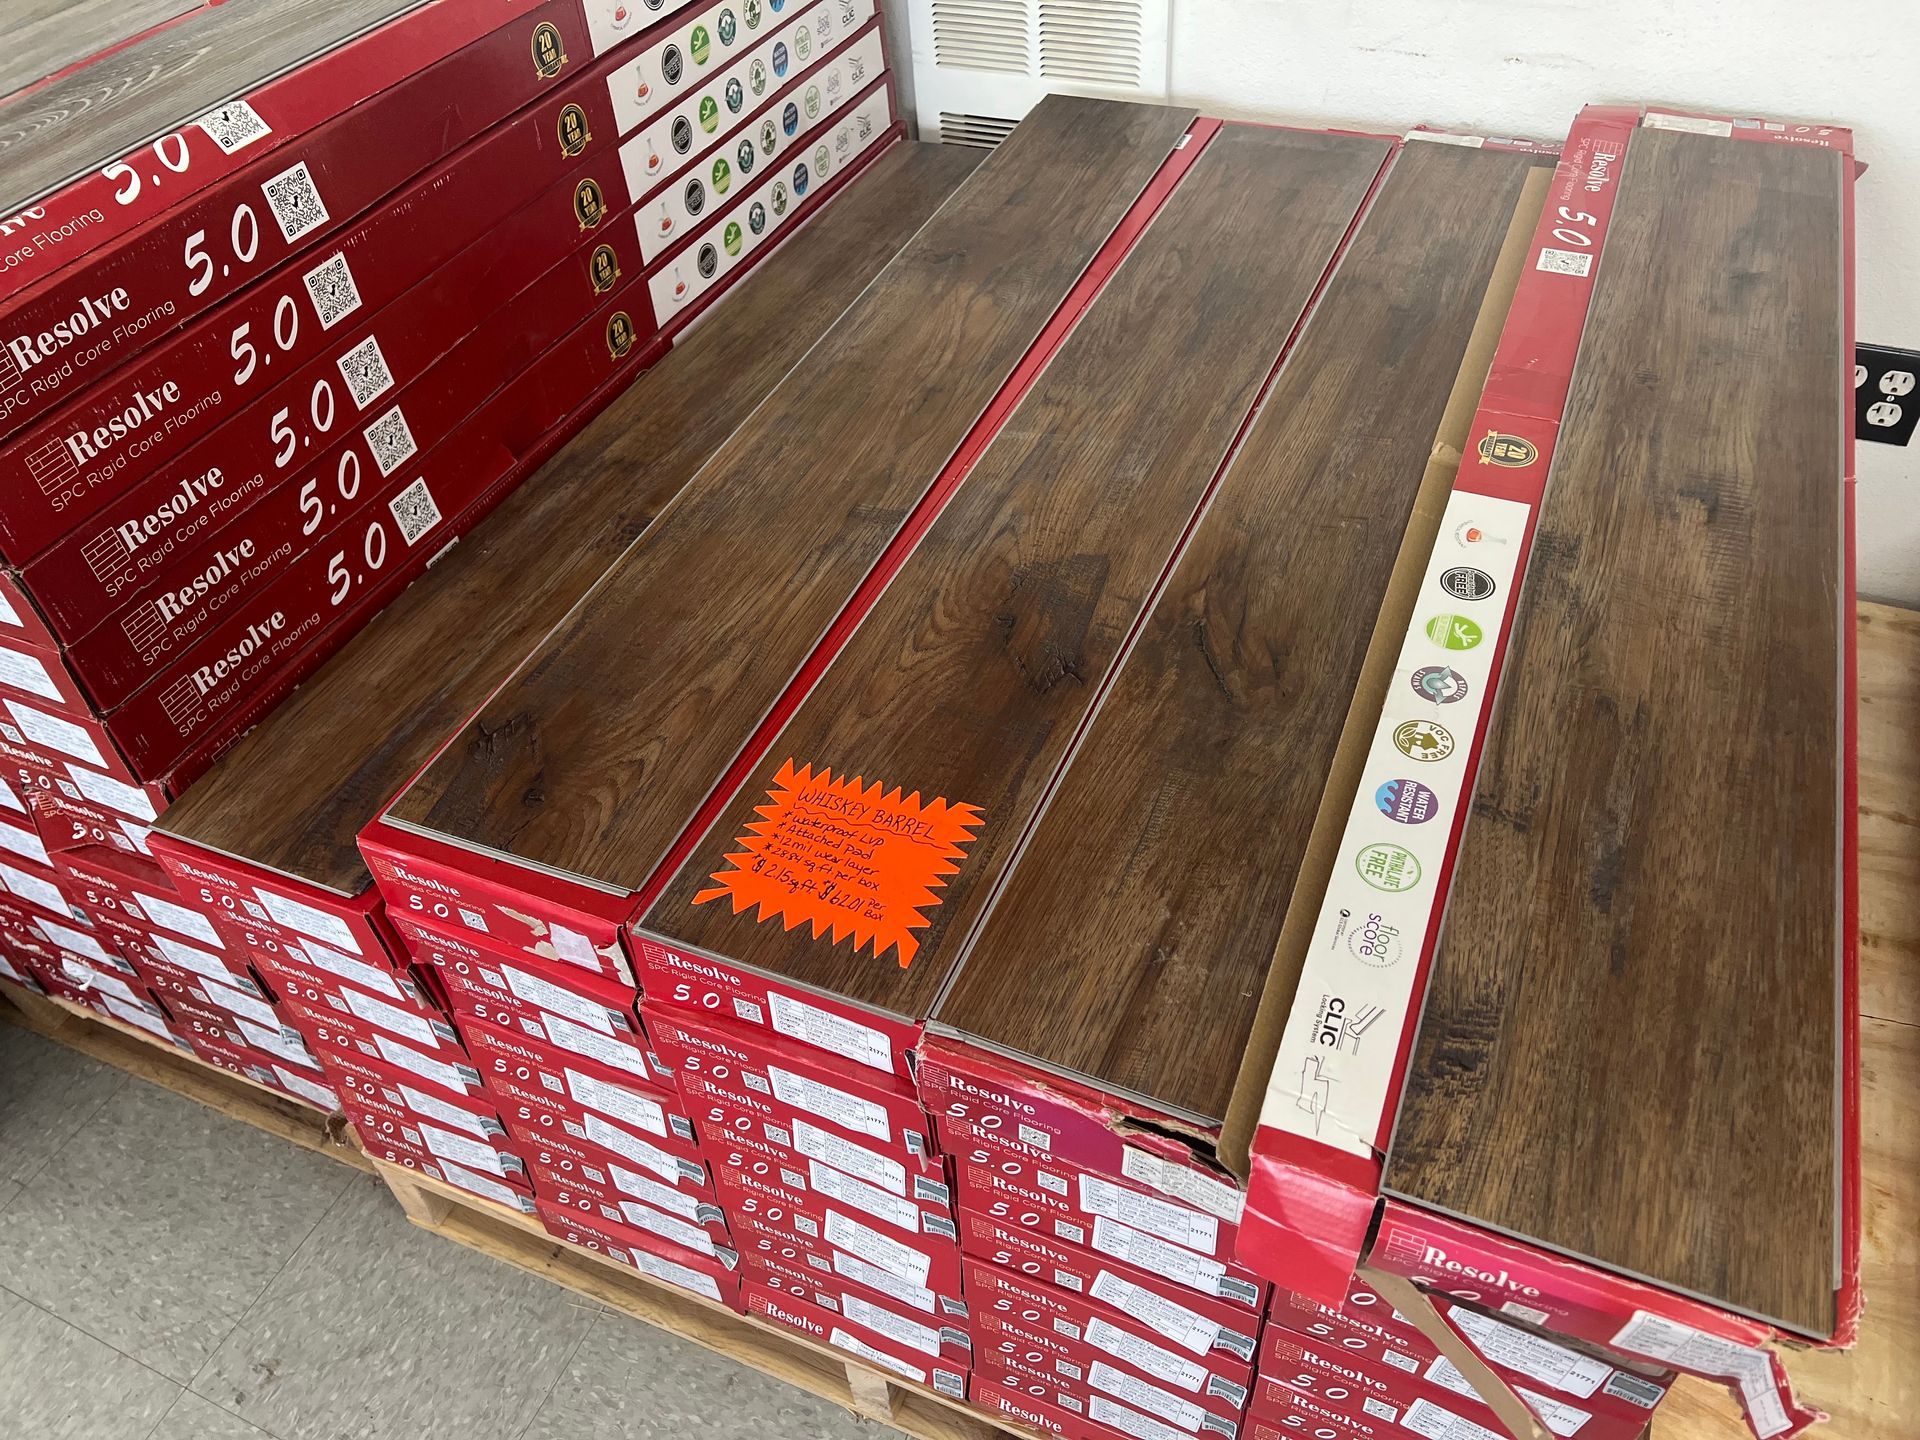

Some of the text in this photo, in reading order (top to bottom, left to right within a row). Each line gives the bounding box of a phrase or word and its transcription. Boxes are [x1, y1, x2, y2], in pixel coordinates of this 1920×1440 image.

[842, 9, 856, 24] CLIC
[538, 31, 552, 53] 20
[852, 66, 865, 81] CLIC
[564, 112, 578, 134] 20
[1580, 137, 1591, 152] SPC
[1774, 134, 1829, 147] Resolve
[101, 132, 190, 205] 5.0
[1573, 152, 1585, 165] Rigid
[1584, 151, 1616, 192] Resolve
[580, 186, 593, 206] 20
[1560, 174, 1575, 201] Flooring
[32, 207, 104, 250] Flooring
[1552, 206, 1597, 246] 5.0
[185, 203, 259, 296] 5.0
[596, 252, 608, 271] 20
[7, 286, 130, 373] Resolve
[230, 294, 299, 386] 5.0
[613, 319, 624, 337] 20
[30, 362, 73, 396] Rigid
[74, 339, 111, 368] Core
[112, 300, 176, 344] Flooring
[64, 380, 181, 466] Resolve
[271, 379, 334, 468] 5.0
[51, 390, 222, 512] SPC Rigid Core Flooring
[1507, 444, 1528, 460] 20
[300, 450, 360, 536] 5.0
[117, 467, 224, 553] Resolve
[105, 473, 264, 598] SPC Rigid Core Flooring
[327, 522, 386, 606] 5.0
[155, 538, 255, 623] Resolve
[1454, 571, 1468, 595] FREE
[142, 542, 292, 666] SPC Rigid Core Flooring
[191, 610, 286, 696] Resolve
[179, 612, 321, 737] SPC Rigid Core Flooring
[1412, 669, 1426, 690] STAINS
[1453, 679, 1468, 699] REPELS
[1421, 724, 1450, 760] VOC FREE
[798, 787, 935, 840] WHISKEY BARREL
[1396, 780, 1418, 823] RESISTANT
[1412, 791, 1431, 821] WATER
[72, 821, 105, 841] 5.0
[786, 824, 874, 860] Attached pad
[180, 862, 239, 889] Resolve
[814, 850, 843, 863] wear
[844, 858, 880, 876] layer
[1365, 850, 1388, 879] FREE
[394, 865, 460, 898] Resolve
[834, 871, 856, 882] per
[858, 877, 880, 891] box
[200, 889, 235, 909] 5.0
[409, 894, 449, 918] 5.0
[864, 909, 884, 921] Box
[417, 927, 479, 958] Resolve
[1360, 912, 1382, 956] score
[1373, 924, 1400, 962] floor
[433, 952, 470, 975] 5.0
[667, 953, 742, 986] Resolve
[462, 979, 523, 1008] Resolve
[648, 962, 767, 1005] SPC Rigid Core Flooring
[673, 984, 720, 1009] 5.0
[475, 1004, 511, 1026] 5.0
[1310, 994, 1329, 1043] Locking System
[1319, 997, 1345, 1047] CLIC
[676, 1030, 749, 1062] Resolve
[869, 1046, 888, 1058] 21771
[684, 1056, 729, 1079] 5.0
[686, 1088, 706, 1099] SPC
[707, 1094, 731, 1108] Rigid
[733, 1103, 755, 1116] Core
[704, 1081, 772, 1114] Resolve
[924, 1081, 1061, 1135] SPC Rigid Core Flooring
[950, 1076, 1037, 1115] Resolve
[708, 1107, 751, 1130] 5.0
[946, 1102, 1003, 1129] 5.0
[723, 1129, 788, 1159] Resolve
[971, 1124, 1053, 1163] Resolve
[727, 1152, 769, 1174] 5.0
[969, 1150, 1022, 1175] 5.0
[740, 1174, 804, 1206] Resolve
[992, 1175, 1070, 1212] Resolve
[742, 1198, 783, 1221] 5.0
[989, 1202, 1040, 1226] 5.0
[752, 1220, 814, 1248] Resolve
[995, 1228, 1068, 1263] Resolve
[1190, 1227, 1212, 1239] 21771
[757, 1239, 796, 1259] 5.0
[992, 1251, 1041, 1275] 5.0
[763, 1259, 824, 1288] Resolve
[1423, 1246, 1540, 1297] Resolve
[993, 1299, 1041, 1321] 5.0
[997, 1279, 1068, 1313] Resolve
[766, 1301, 824, 1335] Resolve
[1192, 1326, 1212, 1339] 21771
[1318, 1304, 1408, 1347] Resolve
[1001, 1321, 1069, 1354] Resolve
[1306, 1323, 1368, 1349] 5.0
[998, 1341, 1043, 1363] 5.0
[1302, 1350, 1388, 1391] Resolve
[1569, 1370, 1596, 1384] 21771
[1291, 1374, 1349, 1399] 5.0
[999, 1398, 1062, 1433] Resolve
[1281, 1415, 1337, 1439] 5.0
[1293, 1395, 1374, 1434] Resolve
